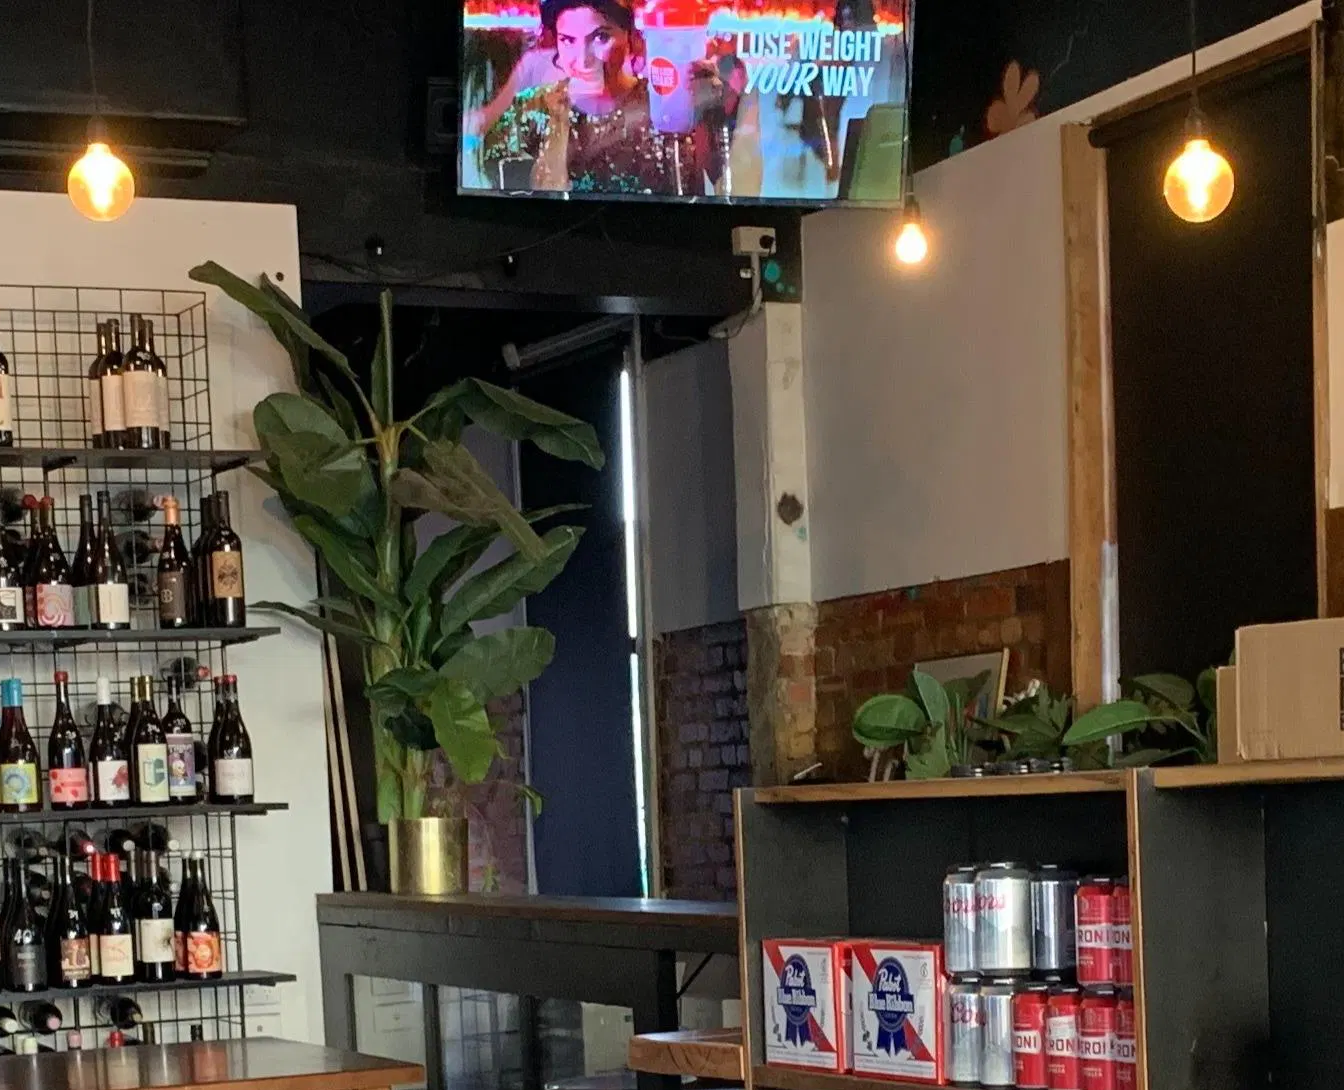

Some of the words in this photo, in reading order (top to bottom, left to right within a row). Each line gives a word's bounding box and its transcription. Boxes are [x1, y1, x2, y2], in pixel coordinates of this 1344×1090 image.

[736, 30, 793, 60] LOSE
[800, 31, 883, 62] WEIGHT
[744, 62, 820, 96] YOUR
[822, 66, 874, 97] WAY
[14, 928, 33, 944] 40
[878, 968, 902, 992] Pabst
[869, 993, 886, 1011] Blue
[885, 993, 914, 1013] Ribbon
